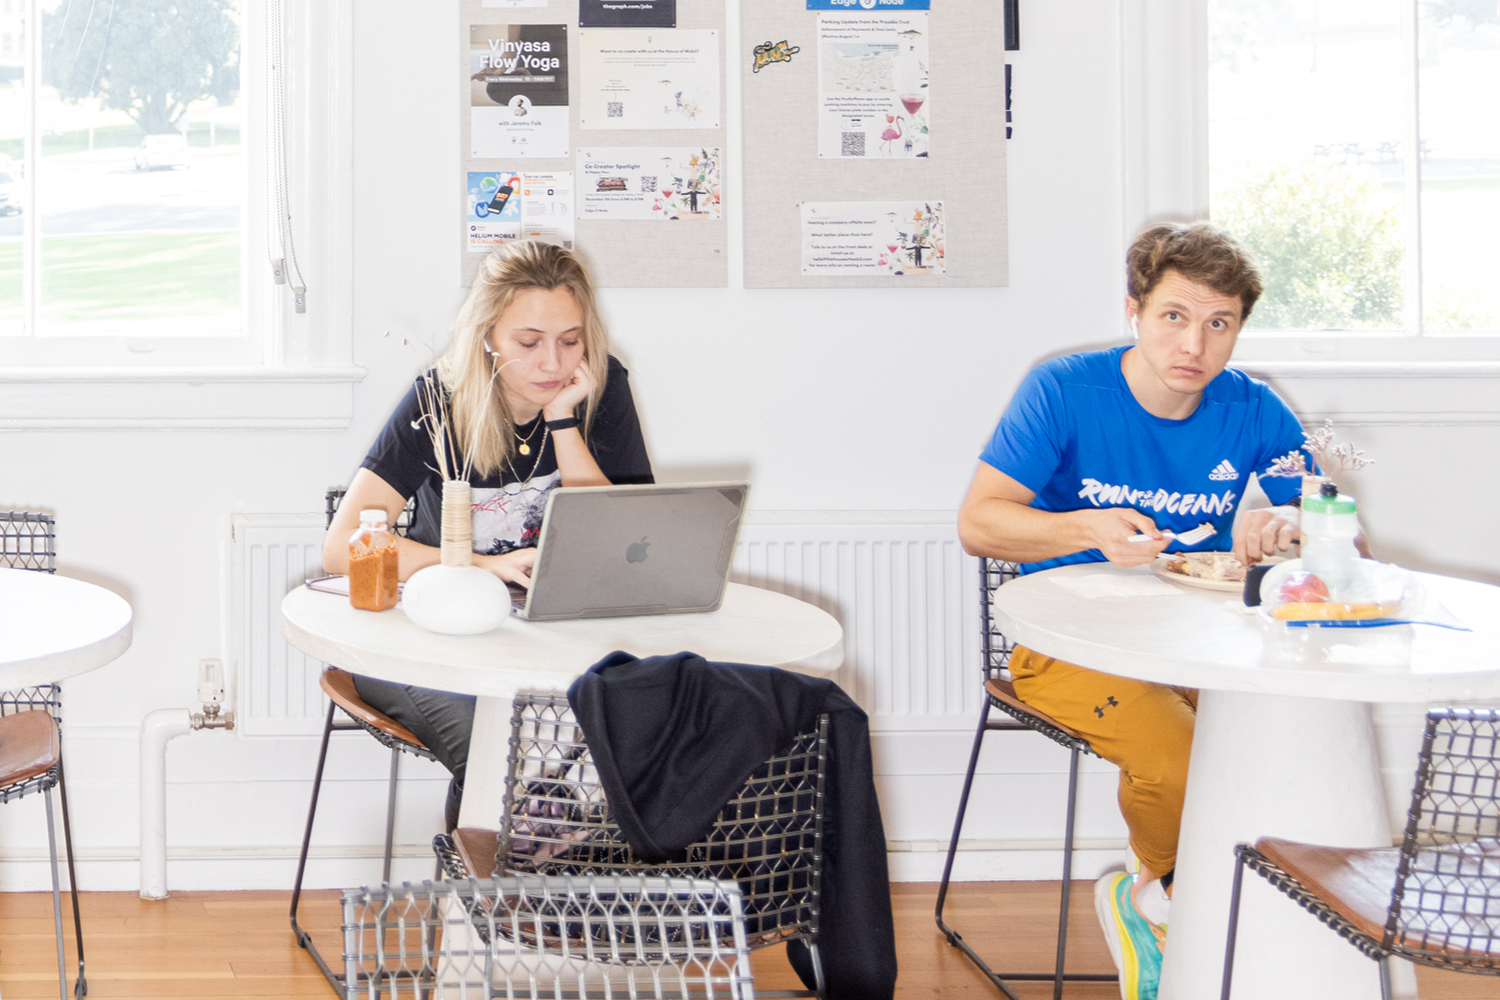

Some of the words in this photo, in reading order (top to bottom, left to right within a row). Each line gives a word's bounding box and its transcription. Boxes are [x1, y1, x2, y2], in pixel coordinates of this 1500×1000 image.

[487, 38, 551, 55] Vinyasa
[480, 55, 517, 68] Flow
[520, 55, 560, 72] Yoga
[1208, 472, 1240, 481] adidas
[1078, 478, 1138, 507] RUN
[1152, 488, 1236, 517] OCEANS
